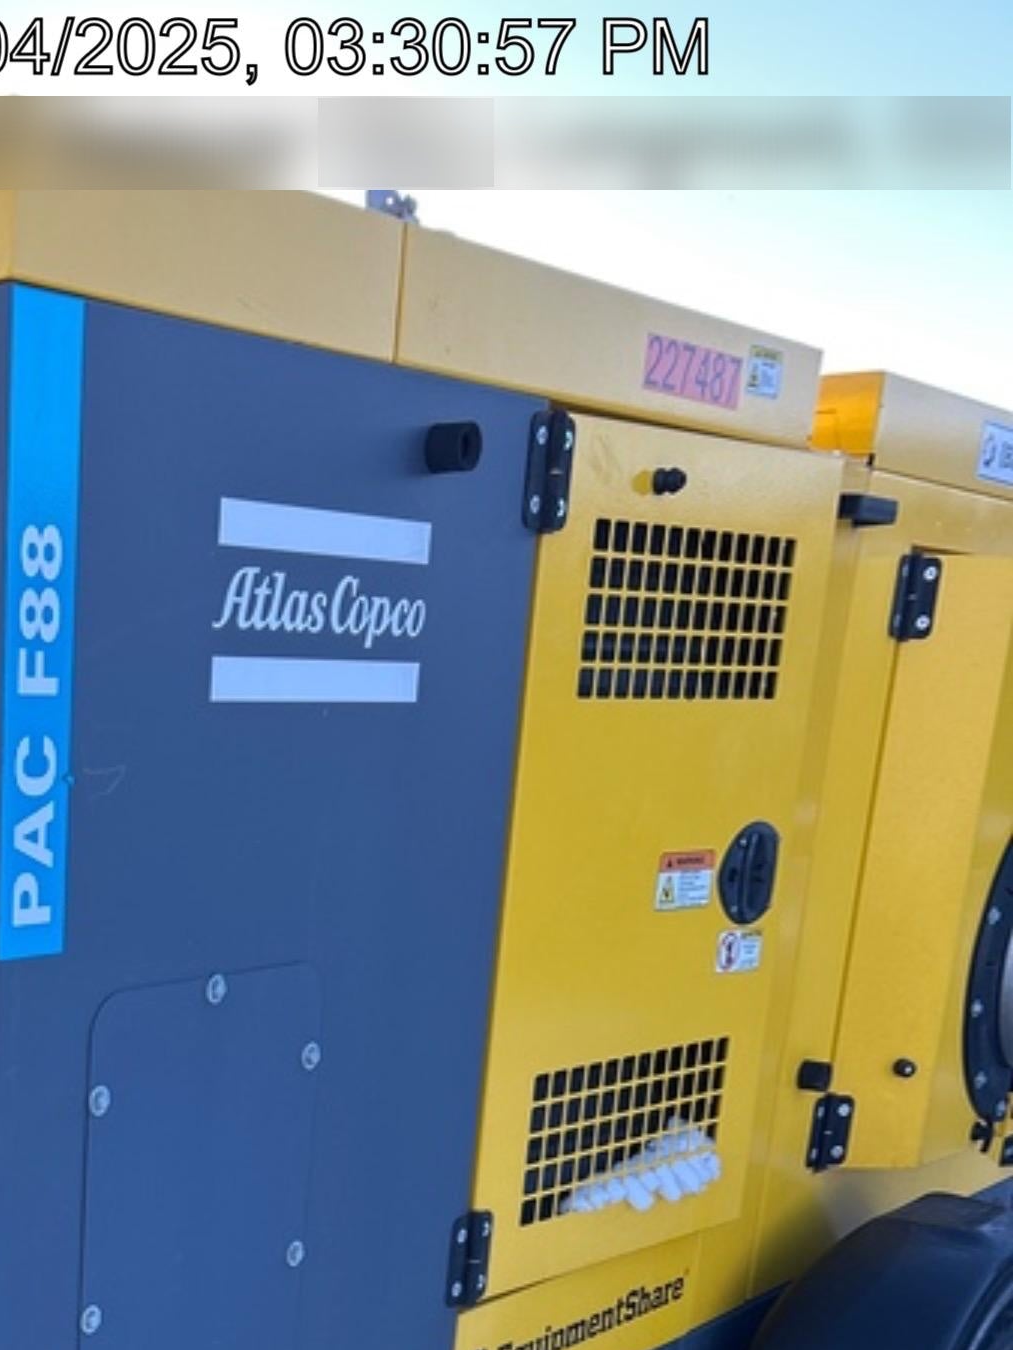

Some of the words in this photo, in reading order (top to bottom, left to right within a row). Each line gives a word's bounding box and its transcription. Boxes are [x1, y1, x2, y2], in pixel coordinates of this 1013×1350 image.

[644, 335, 743, 408] 227487
[18, 524, 63, 697] F88
[13, 735, 57, 928] PAC
